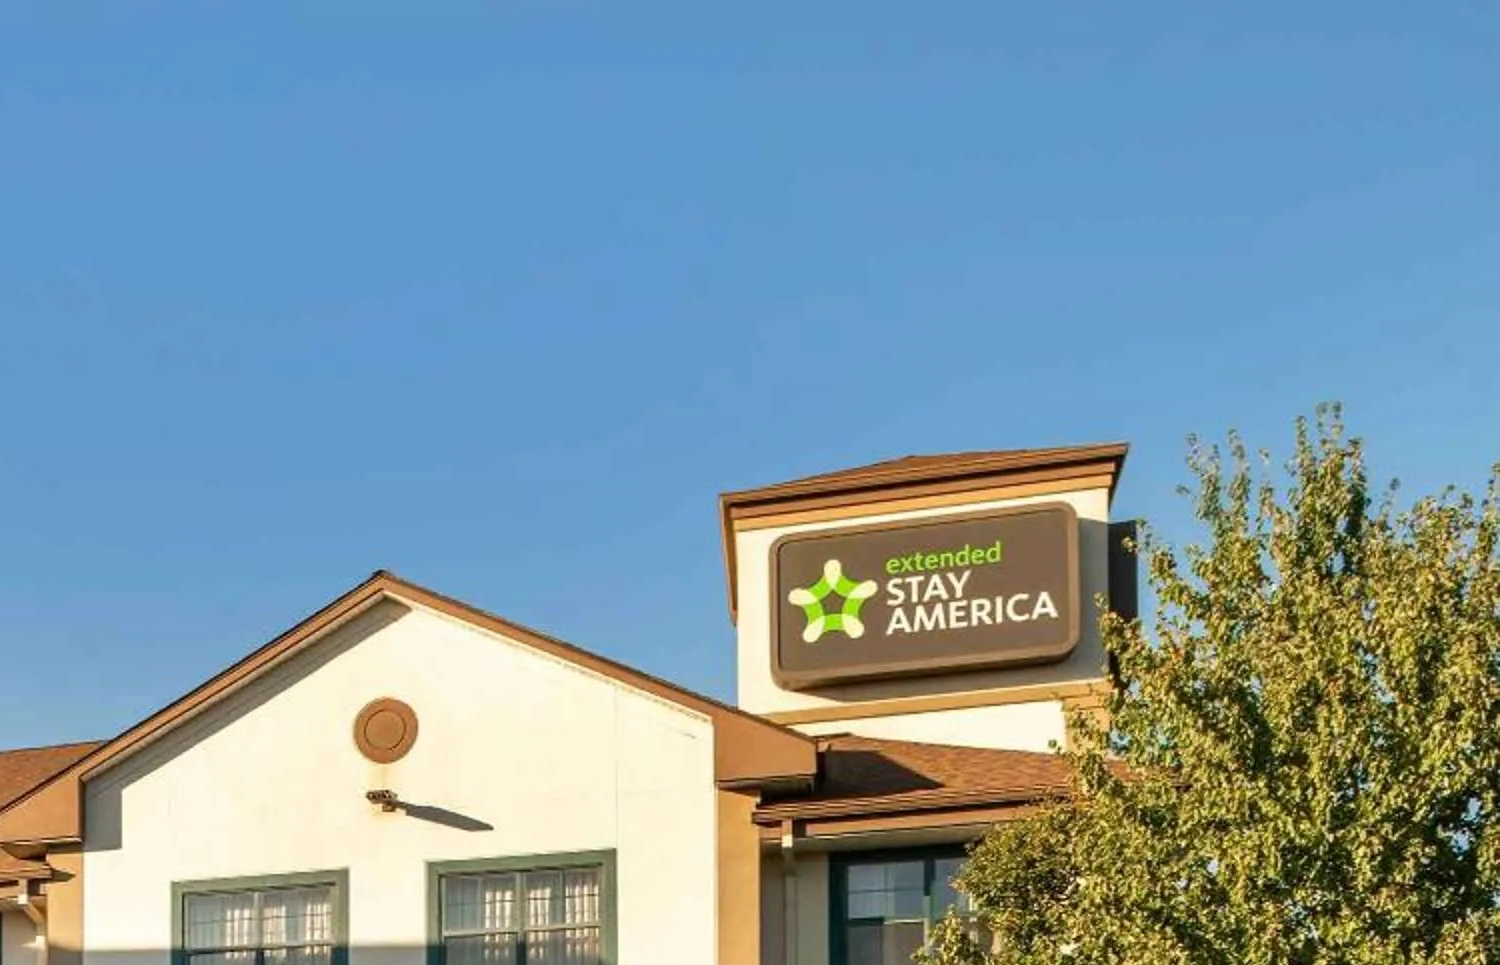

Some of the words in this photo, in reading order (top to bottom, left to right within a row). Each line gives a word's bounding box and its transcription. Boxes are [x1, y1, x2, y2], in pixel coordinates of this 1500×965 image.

[886, 541, 1002, 575] extended
[886, 570, 972, 606] STAY
[886, 591, 1059, 636] AMERICA
